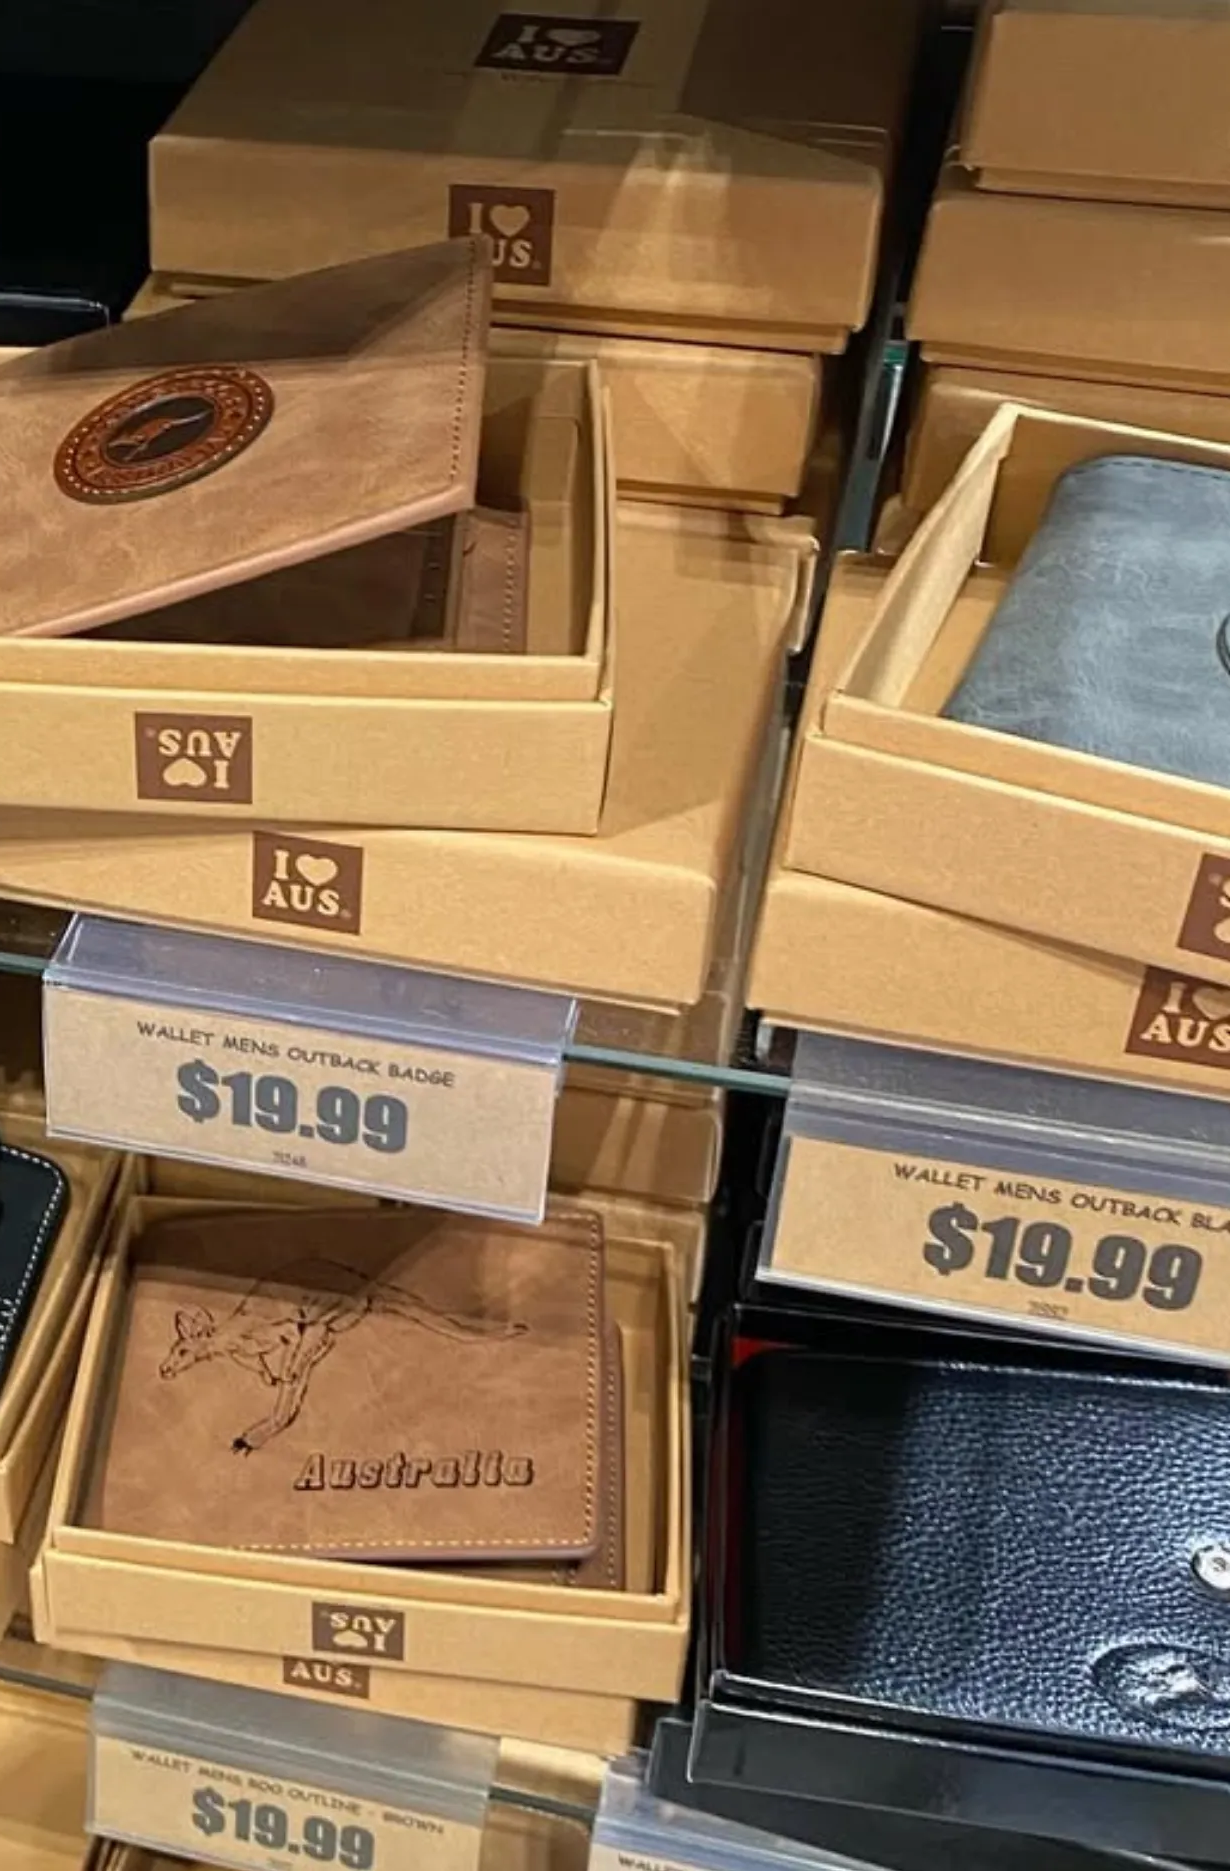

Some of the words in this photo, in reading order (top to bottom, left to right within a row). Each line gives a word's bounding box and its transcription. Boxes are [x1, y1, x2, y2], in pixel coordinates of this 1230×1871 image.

[491, 239, 532, 268] US
[137, 1021, 216, 1046] WALLET
[223, 1035, 280, 1058] MENS
[287, 1047, 382, 1076] OUTBACK
[388, 1063, 457, 1088] BADGE
[175, 1057, 408, 1154] $19.99
[893, 1163, 987, 1192] WALLET
[994, 1180, 1063, 1204] MENS
[1070, 1192, 1183, 1227] OUTBACK
[922, 1201, 1203, 1312] $19.99
[293, 1450, 535, 1491] Australia
[133, 1750, 191, 1775] WALLET
[198, 1766, 242, 1786] MENS
[248, 1777, 284, 1796] ROO
[288, 1788, 362, 1816] OUTLINE
[382, 1812, 446, 1835] BROWN
[191, 1786, 375, 1870] $19.99
